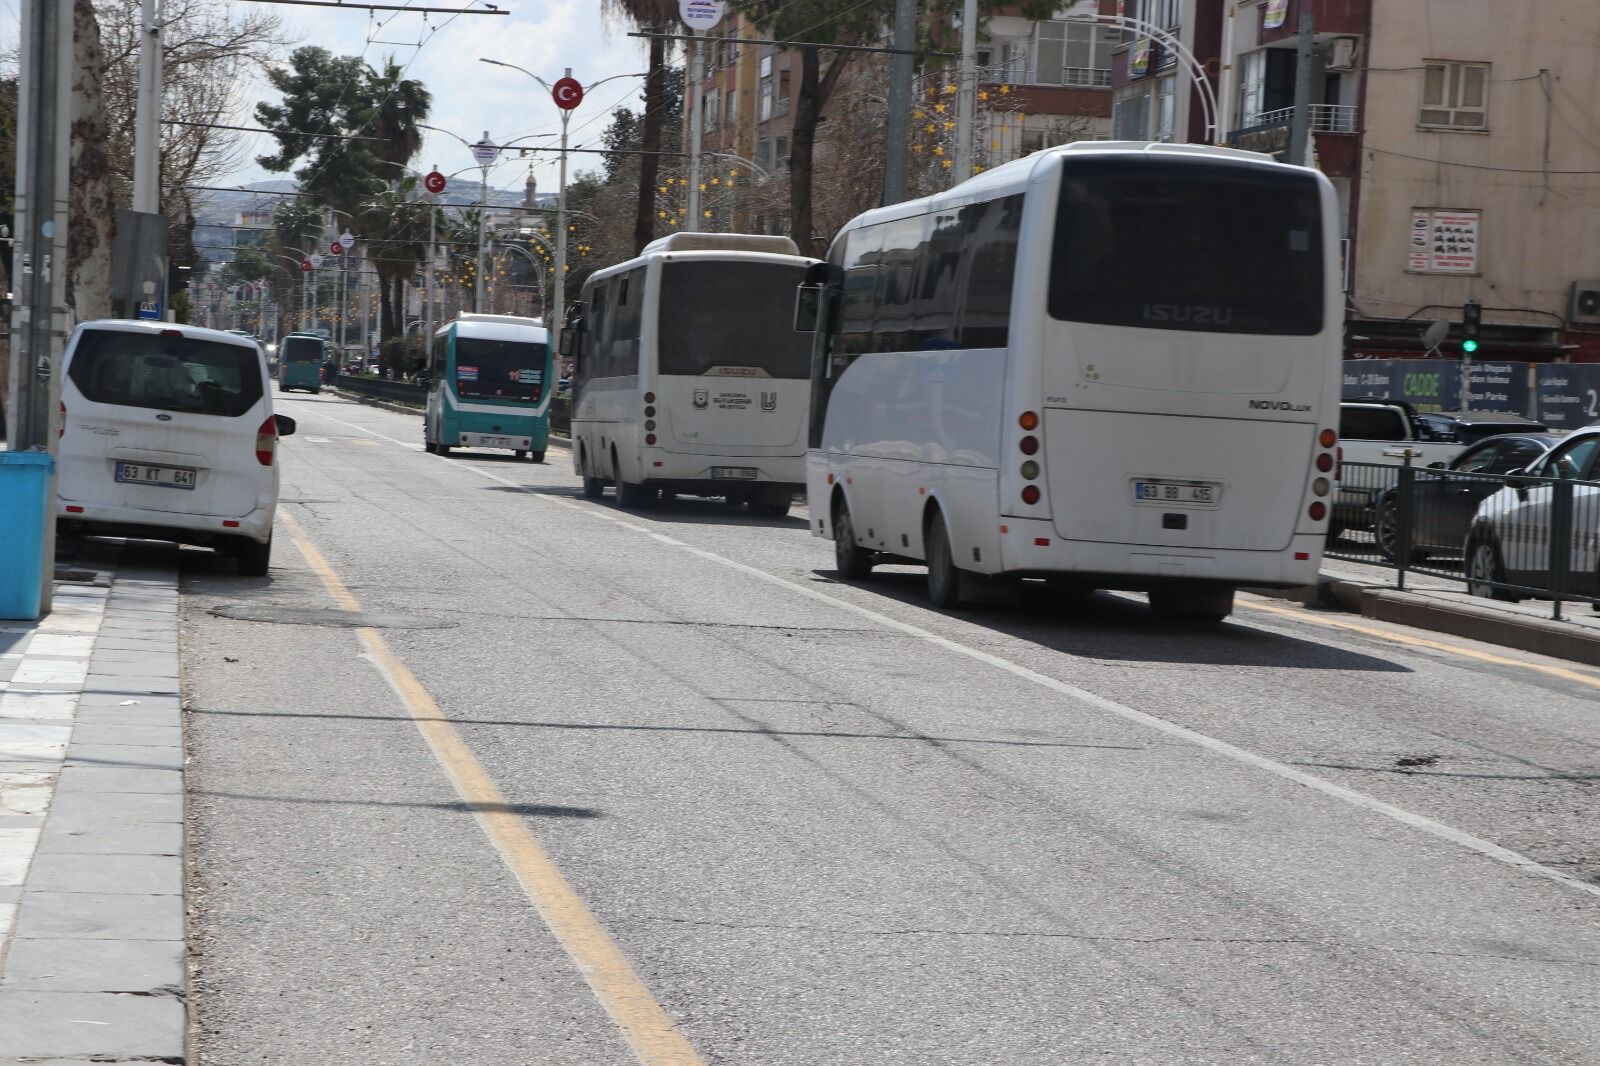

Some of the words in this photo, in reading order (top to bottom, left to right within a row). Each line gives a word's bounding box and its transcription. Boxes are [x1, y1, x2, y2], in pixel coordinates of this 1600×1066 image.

[1143, 303, 1233, 325] ISUZU
[1404, 373, 1440, 397] CADDE
[125, 465, 138, 479] 63
[146, 468, 160, 481] KT
[174, 471, 194, 485] 641
[1144, 485, 1158, 498] 63
